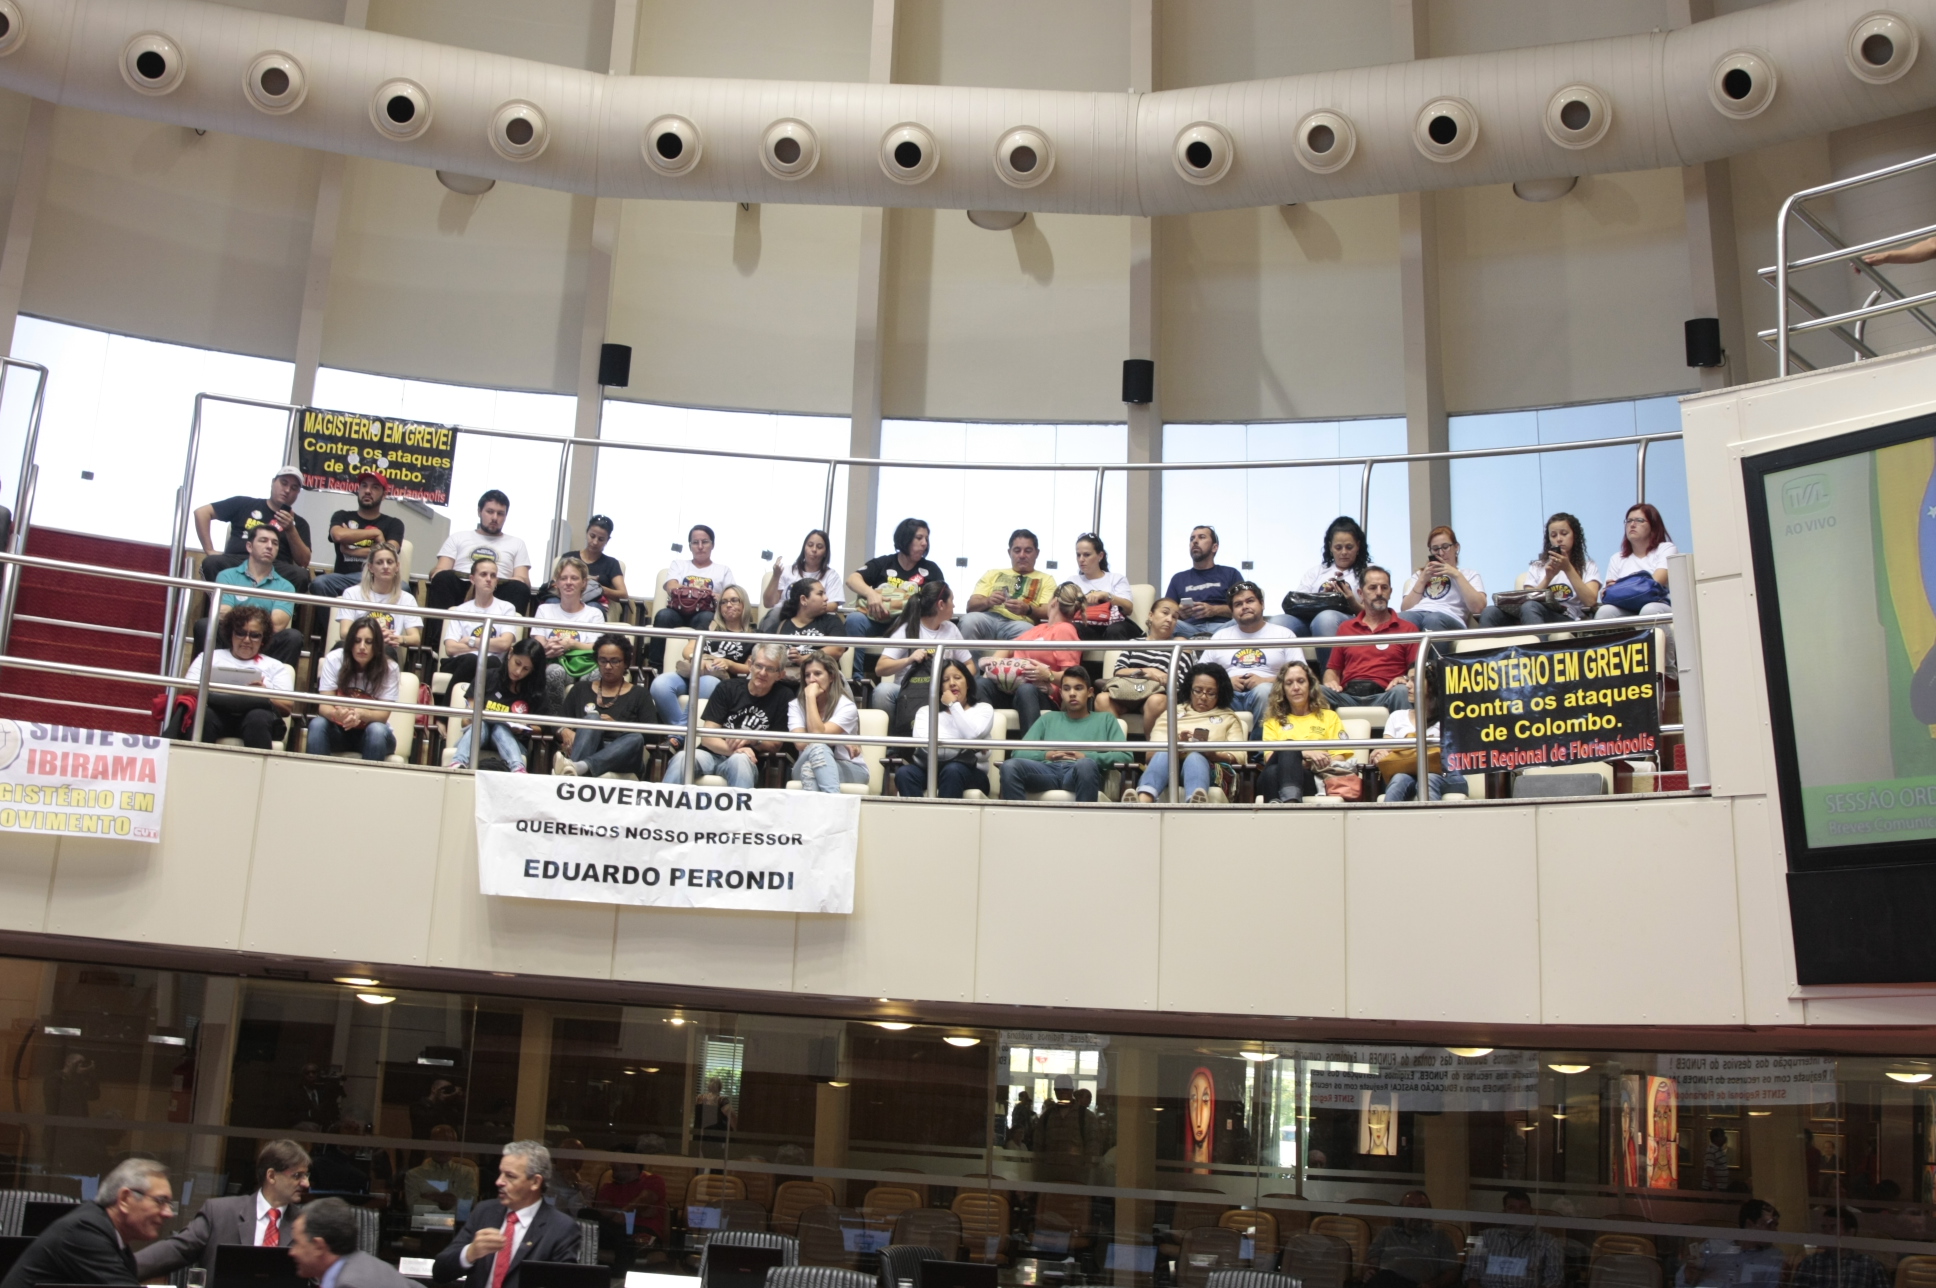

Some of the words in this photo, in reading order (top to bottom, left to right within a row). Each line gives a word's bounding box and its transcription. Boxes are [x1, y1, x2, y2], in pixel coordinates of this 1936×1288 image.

[303, 411, 382, 442] MAGISTÉRIO
[383, 424, 402, 445] EM
[405, 425, 453, 450] GREVE!
[304, 438, 358, 455] Contra
[363, 447, 383, 459] os
[387, 449, 451, 469] ataques
[324, 459, 344, 473] de
[302, 473, 326, 489] INTE
[328, 476, 361, 493] Region
[387, 485, 446, 503] Florianópolis
[1785, 522, 1803, 536] AO
[1805, 515, 1837, 533] VIVO
[1445, 651, 1549, 695] MAGISTÉRIO
[1553, 651, 1580, 683] EM
[1583, 642, 1649, 679] GREVE!
[486, 700, 510, 713] BASTA
[1449, 697, 1524, 719] Contra
[1530, 695, 1557, 711] os
[1563, 683, 1653, 708] ataques
[1480, 724, 1508, 742] de
[1514, 712, 1622, 739] Colombo.
[26, 748, 157, 784] IBIRAMA
[1447, 750, 1487, 772] SINTE
[1490, 743, 1547, 770] Regional
[1550, 743, 1567, 762] de
[1569, 732, 1655, 759] Florianópolis
[120, 790, 155, 813] EM
[556, 782, 753, 812] GOVERNADOR
[1825, 787, 1895, 814] SESSÃO
[516, 819, 620, 838] QUEREMOS
[625, 826, 689, 844] NOSSO
[694, 831, 803, 846] PROFESSOR
[1828, 820, 1872, 835] Breves
[523, 858, 661, 887] EDUARDO
[669, 867, 794, 890] PERONDI
